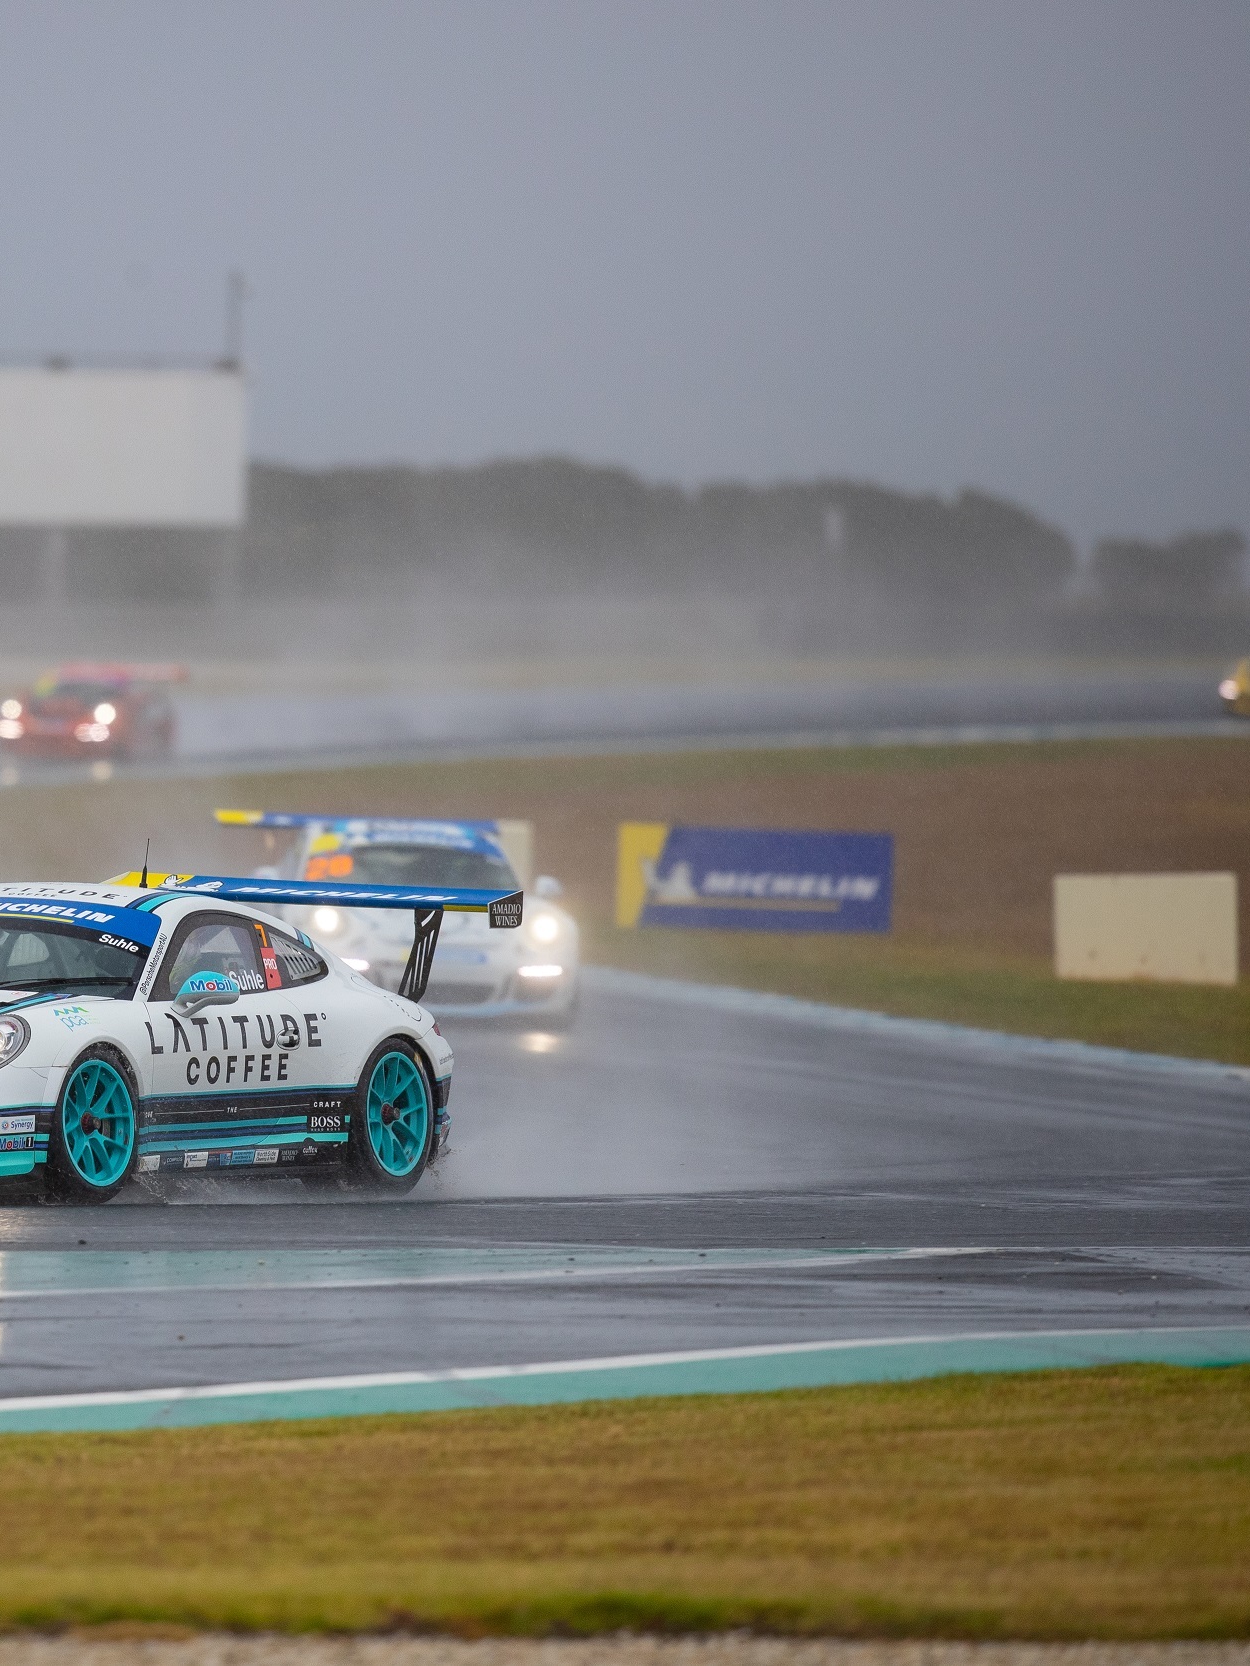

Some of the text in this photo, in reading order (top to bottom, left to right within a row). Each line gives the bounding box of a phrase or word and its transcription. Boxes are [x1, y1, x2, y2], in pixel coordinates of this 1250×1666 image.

[230, 887, 458, 901] MICHELIN
[491, 903, 521, 914] AMADIO
[494, 915, 518, 926] WINES
[253, 924, 267, 947] 7
[99, 934, 139, 953] Suhle
[139, 933, 168, 996] @PorscheMotorsportAU
[263, 958, 277, 970] PRO
[189, 979, 233, 992] Mobil
[229, 970, 264, 990] Suhle
[60, 1015, 89, 1032] pca
[186, 1053, 288, 1085] COFFEE
[11, 1120, 34, 1130] Synergy
[311, 1115, 341, 1128] BOSS
